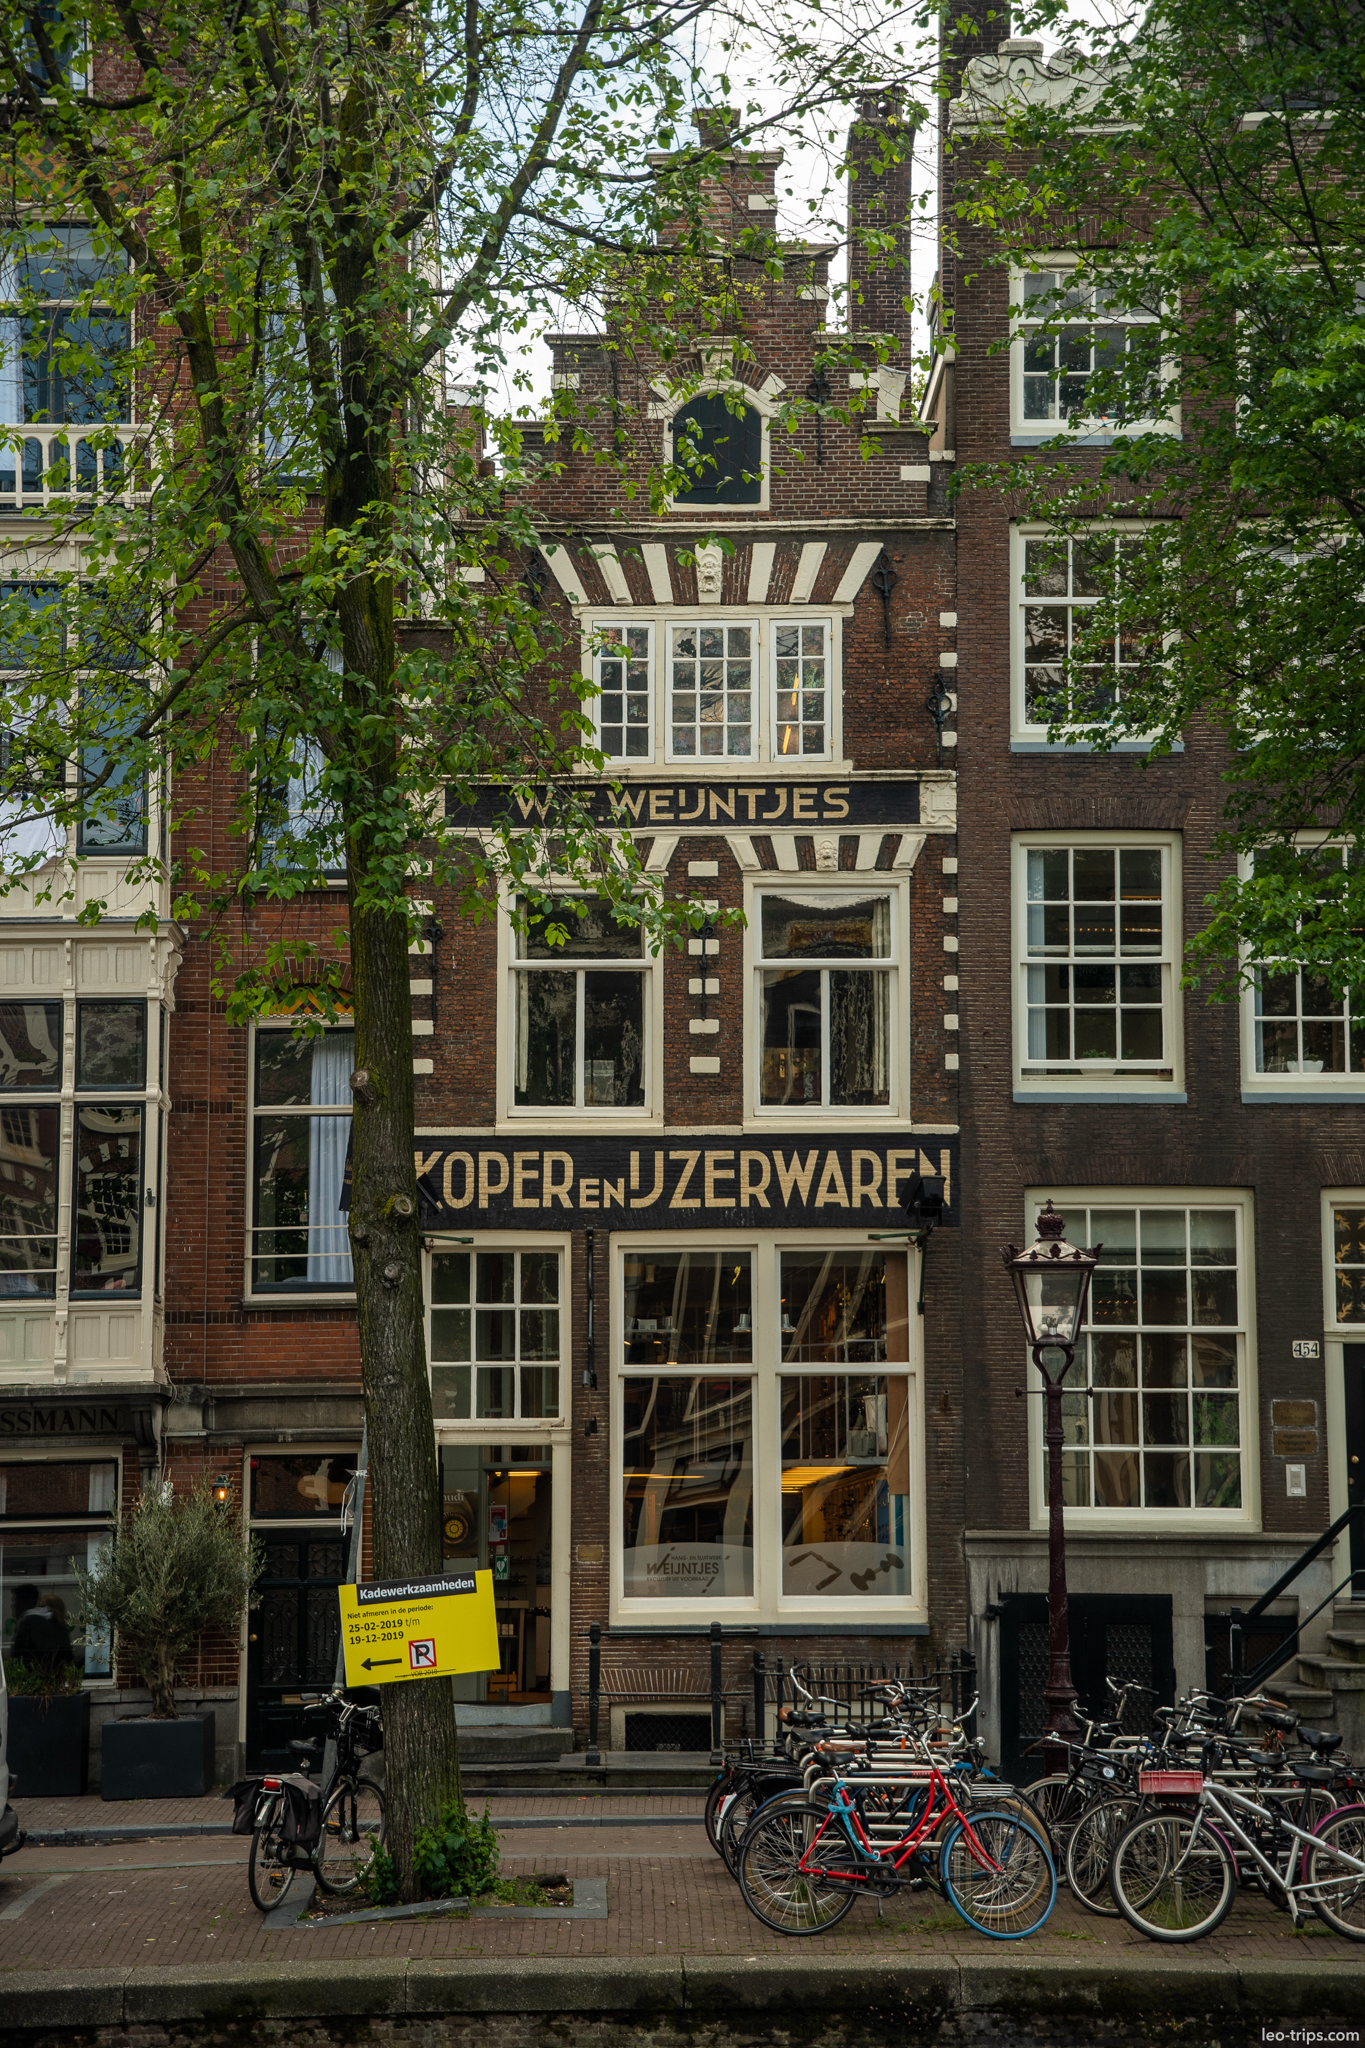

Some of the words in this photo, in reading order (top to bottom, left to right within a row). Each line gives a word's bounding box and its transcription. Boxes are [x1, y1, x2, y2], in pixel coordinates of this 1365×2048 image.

[578, 1177, 625, 1208] EN
[1294, 1342, 1319, 1357] 454
[0, 1408, 118, 1433] SSMANN
[646, 1557, 719, 1575] WEIJNTJES
[360, 1578, 475, 1600] Kadewerkzaamheden
[362, 1609, 389, 1618] afmeren
[407, 1604, 434, 1613] periode:
[348, 1618, 403, 1633] 25-02-2019
[405, 1617, 420, 1628] t/m
[349, 1630, 404, 1645] 19-12-2019
